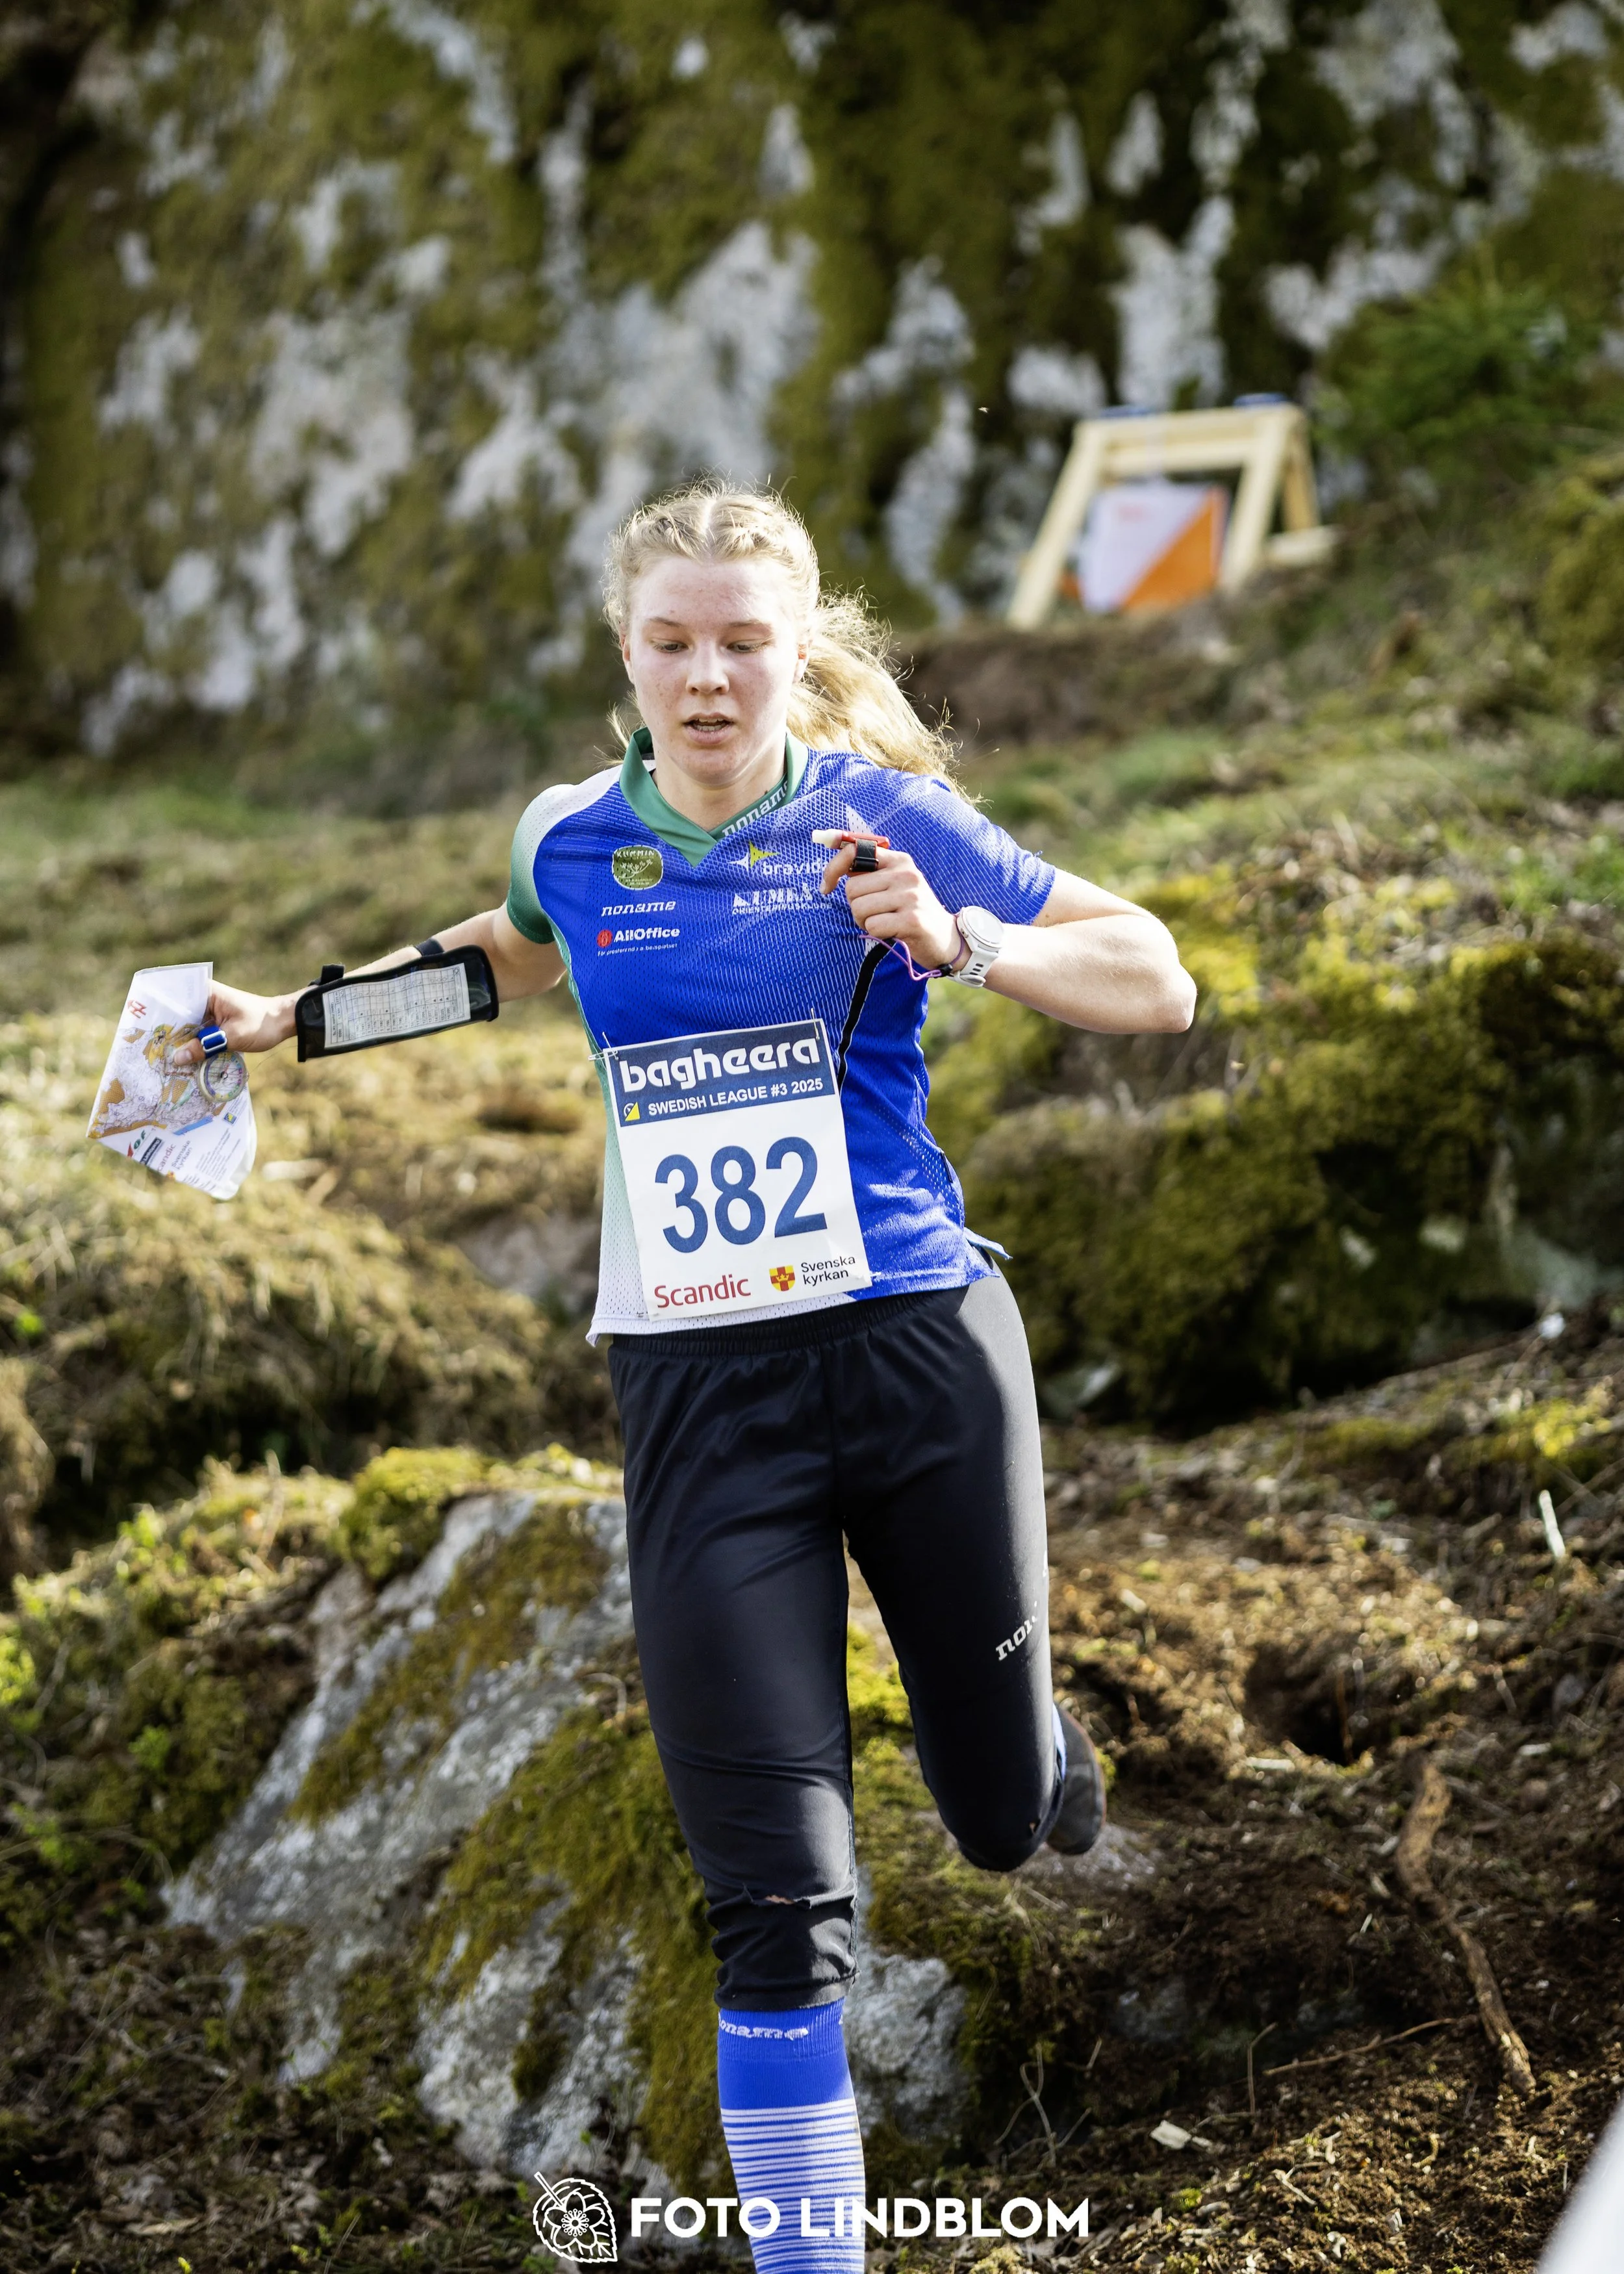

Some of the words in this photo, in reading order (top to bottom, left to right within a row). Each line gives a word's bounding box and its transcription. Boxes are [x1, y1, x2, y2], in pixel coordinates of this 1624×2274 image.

[601, 901, 676, 917] noname
[614, 927, 680, 942] AllOffice
[620, 1038, 820, 1092] bagheera
[648, 1095, 707, 1116] SWEDISH
[710, 1086, 768, 1106] LEAGUE
[770, 1084, 788, 1097] #3
[792, 1078, 824, 1094] 2025
[655, 1136, 828, 1253] 382
[800, 1255, 856, 1272] Svenska
[803, 1270, 849, 1286] kyrkan
[653, 1275, 752, 1308] Scandic
